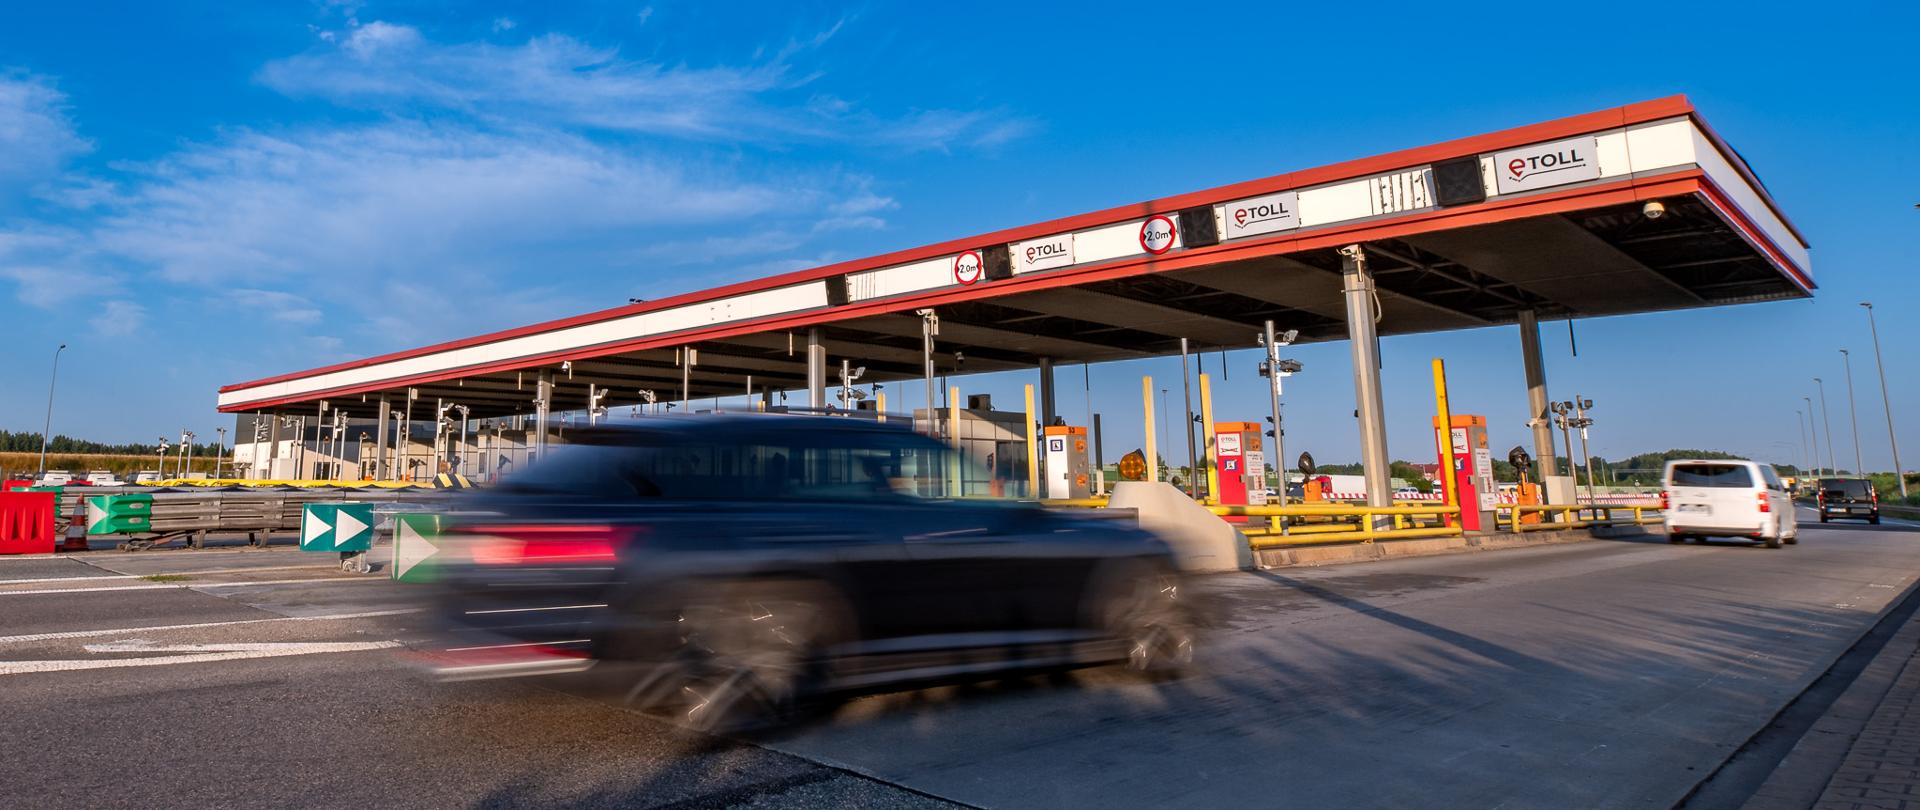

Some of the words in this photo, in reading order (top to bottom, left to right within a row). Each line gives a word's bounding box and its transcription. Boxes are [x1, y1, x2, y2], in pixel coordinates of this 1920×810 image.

[1508, 149, 1584, 177] eTOLL
[1234, 202, 1289, 225] eTOLL
[1026, 242, 1066, 261] eTOLL
